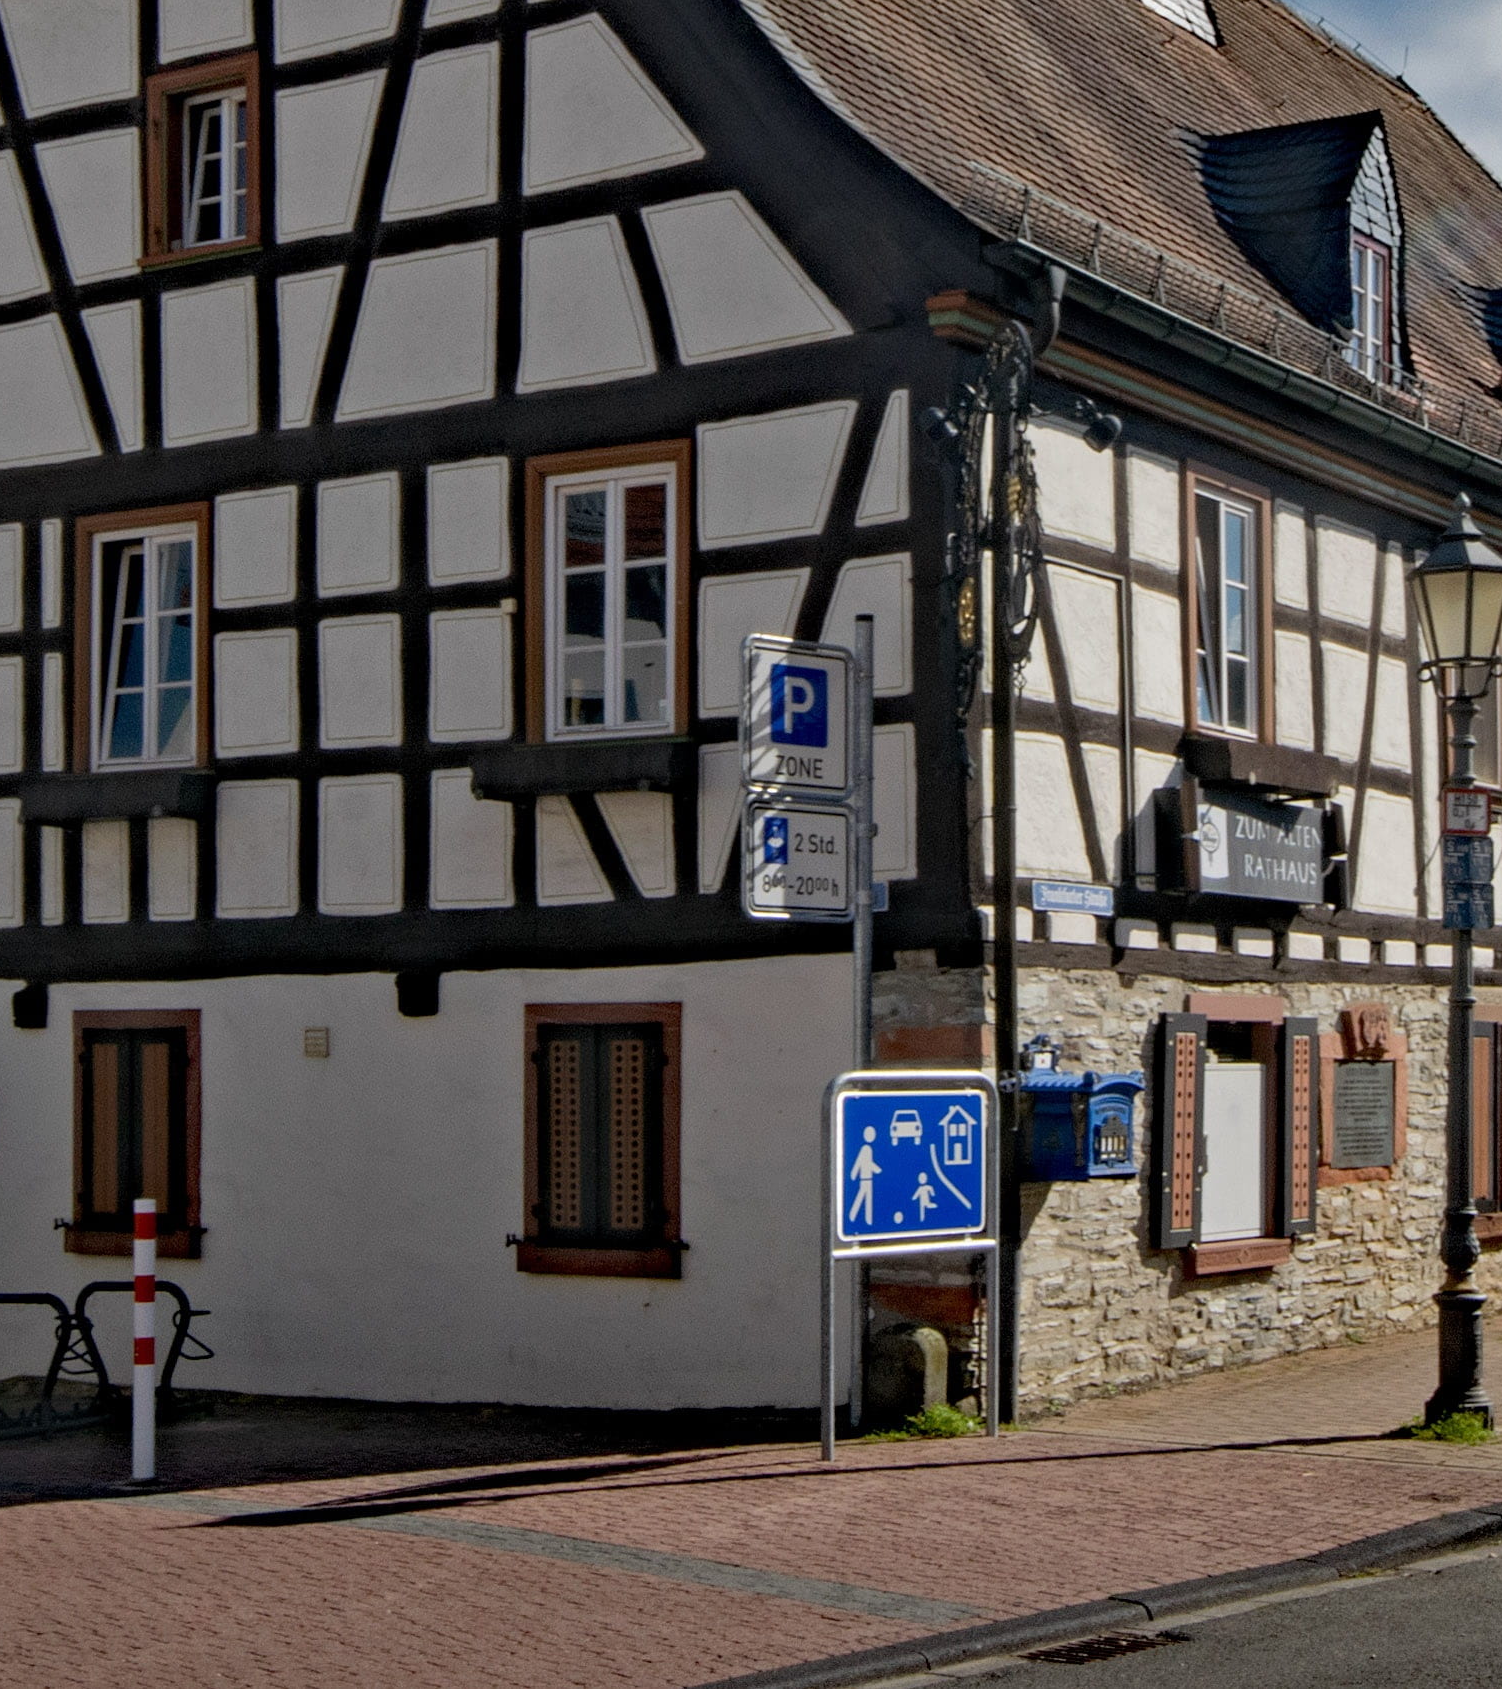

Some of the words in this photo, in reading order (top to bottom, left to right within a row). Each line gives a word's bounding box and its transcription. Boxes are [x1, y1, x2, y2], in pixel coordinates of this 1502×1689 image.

[784, 676, 815, 734] P
[775, 754, 824, 780] ZONE
[794, 833, 804, 853] 2
[808, 834, 838, 854] Std.
[1244, 854, 1317, 885] RATHAUS
